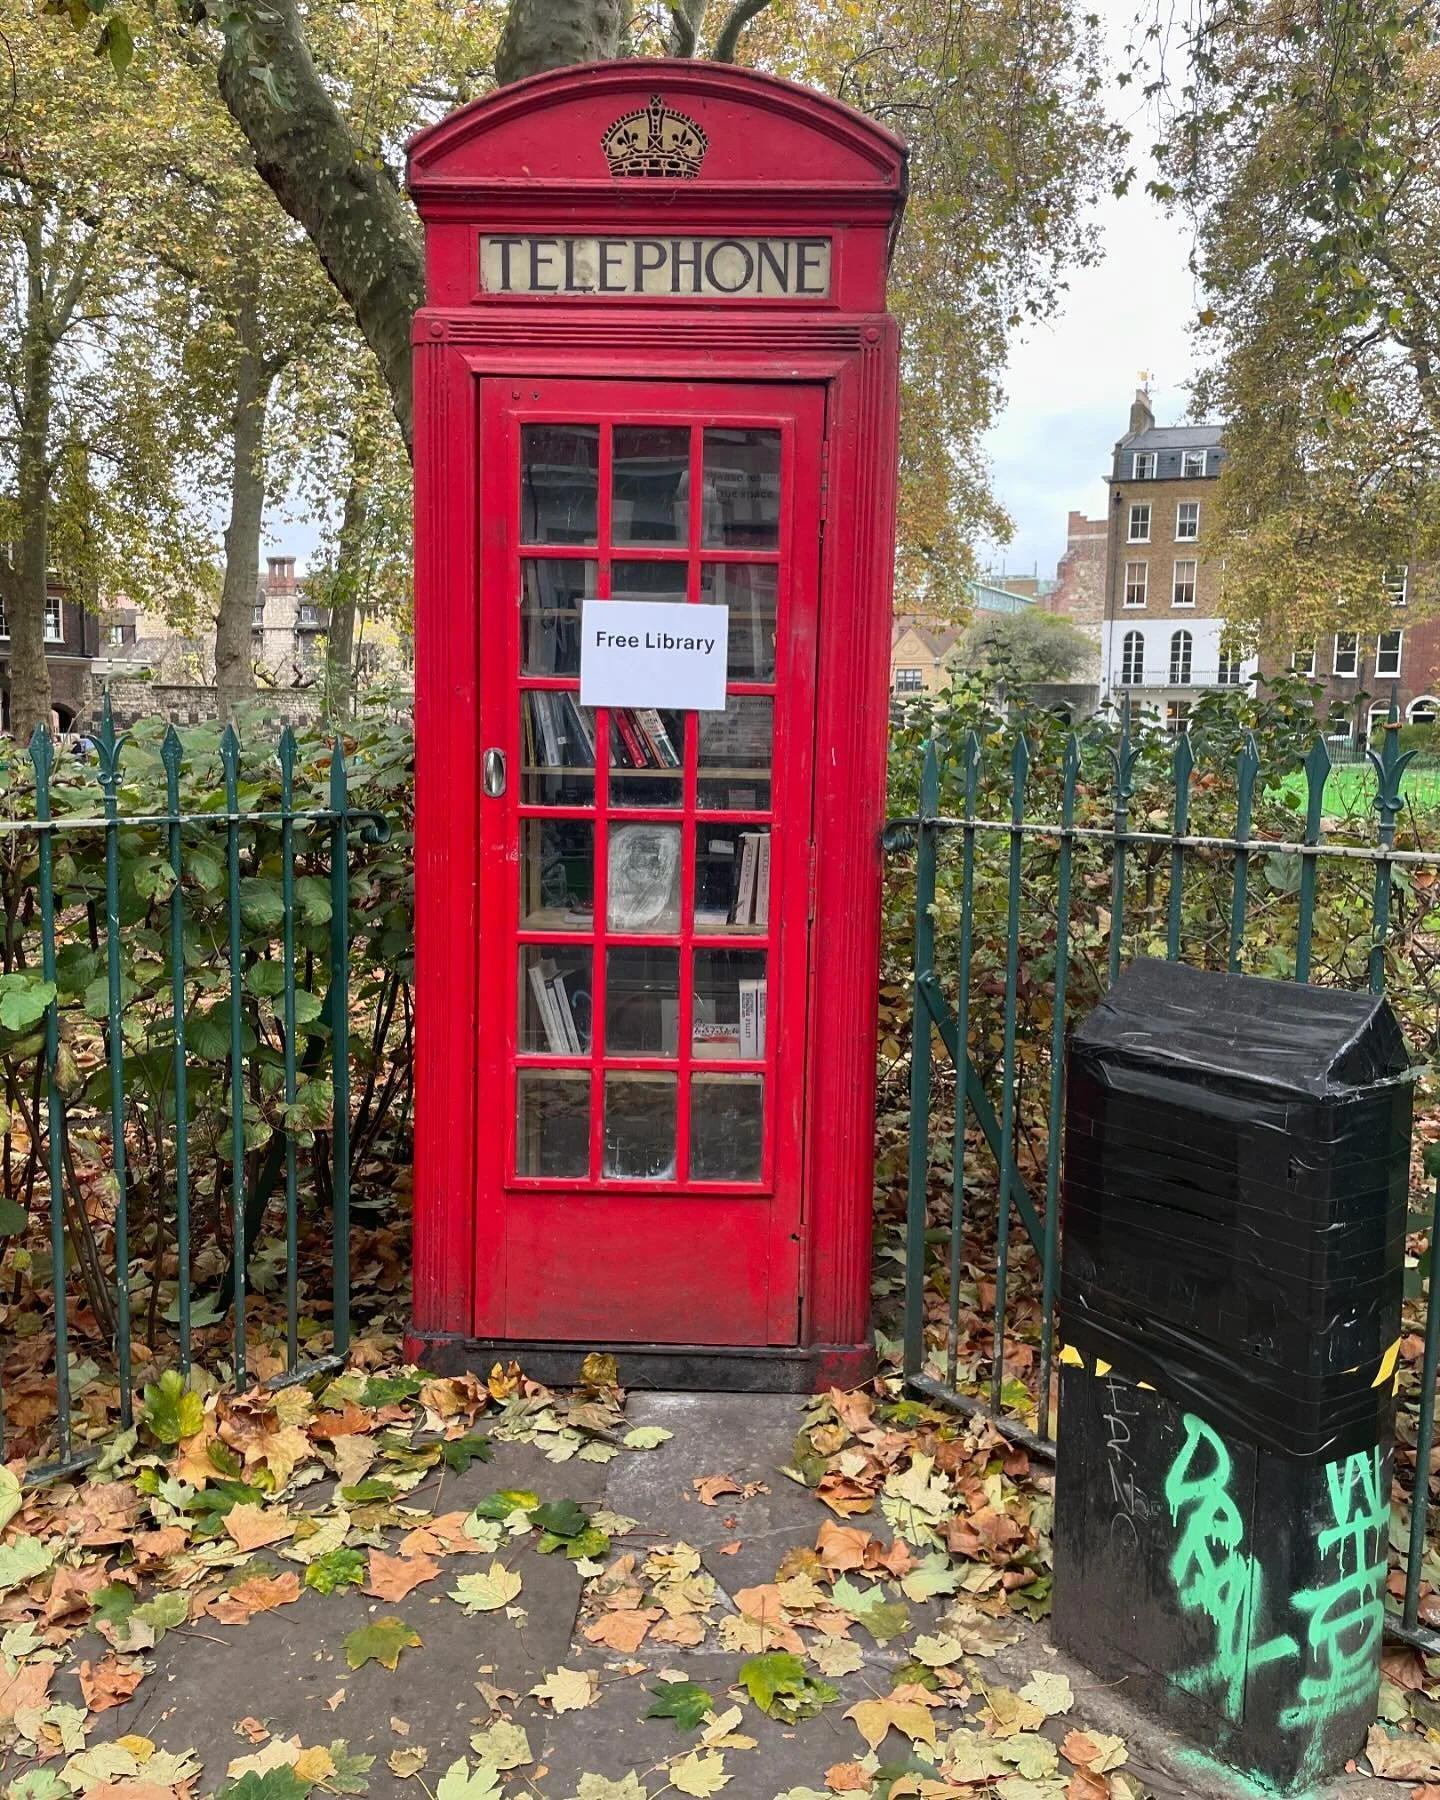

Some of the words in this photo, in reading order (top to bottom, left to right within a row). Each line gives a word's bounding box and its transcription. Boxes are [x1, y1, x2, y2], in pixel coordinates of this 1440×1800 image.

[489, 239, 827, 294] TELEPHONE
[596, 631, 640, 648] Free
[645, 632, 716, 655] Library
